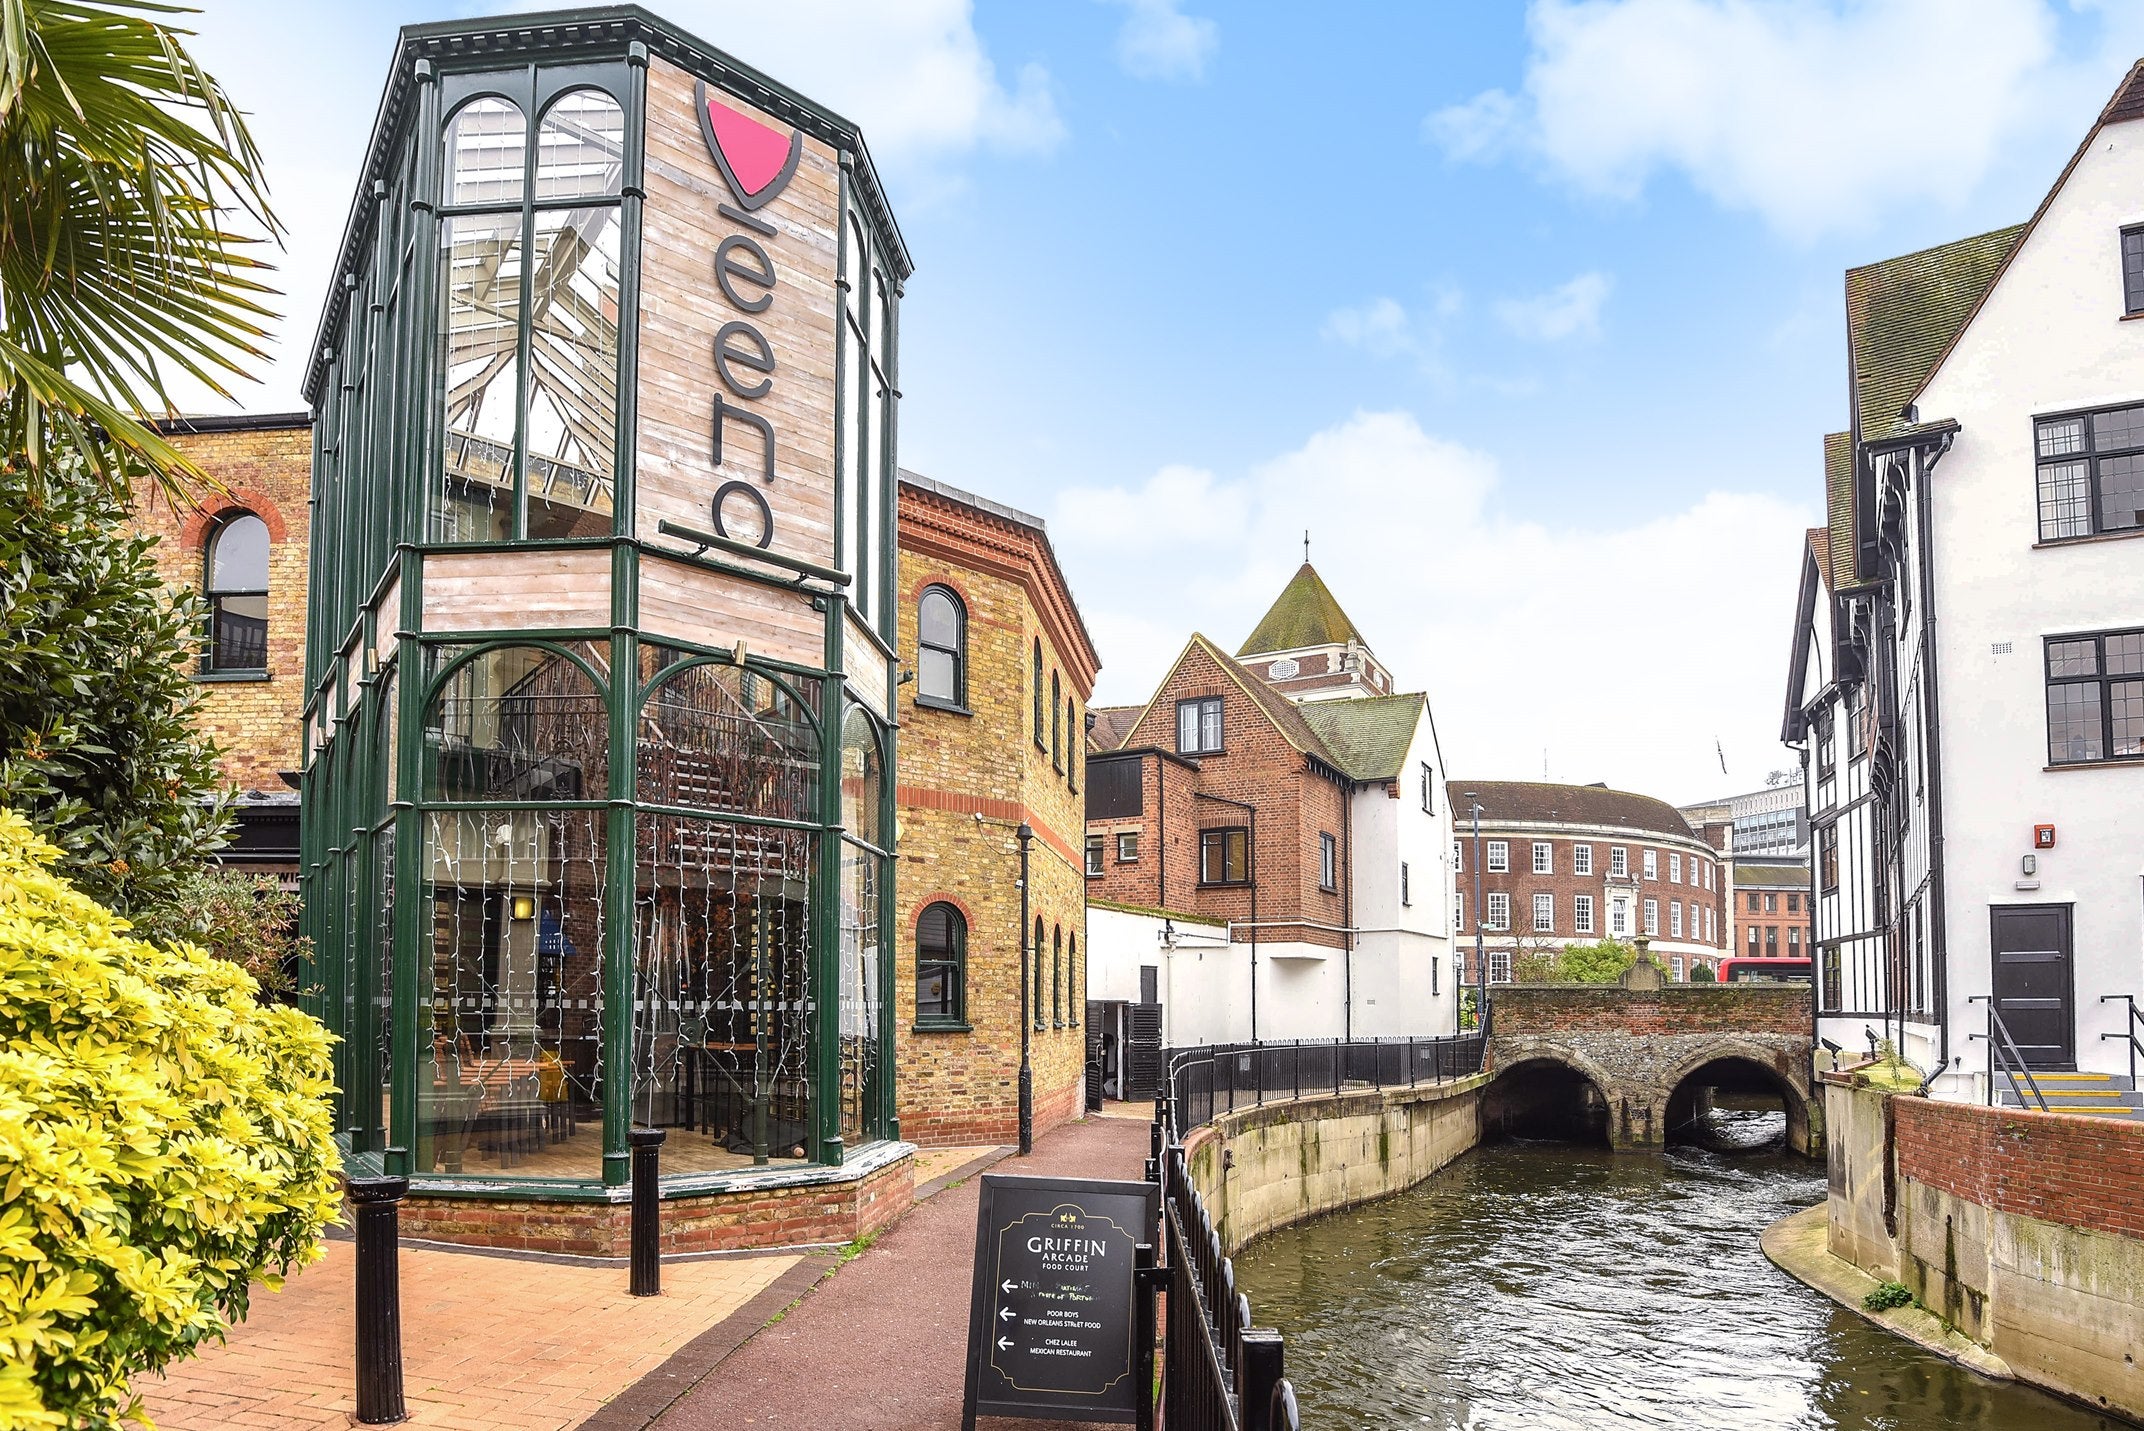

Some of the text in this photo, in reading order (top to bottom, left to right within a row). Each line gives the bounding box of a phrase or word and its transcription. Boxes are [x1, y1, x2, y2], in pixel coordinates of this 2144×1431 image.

[1027, 1236, 1106, 1257] GRIFFIN
[1042, 1252, 1088, 1263] ARCADE
[1065, 1263, 1089, 1271] COURT
[1023, 1318, 1037, 1326] NEW
[1038, 1319, 1063, 1327] ORLEANS
[1061, 1339, 1077, 1347] LALEE
[1029, 1347, 1092, 1357] MEXICAN RESTAURANT
